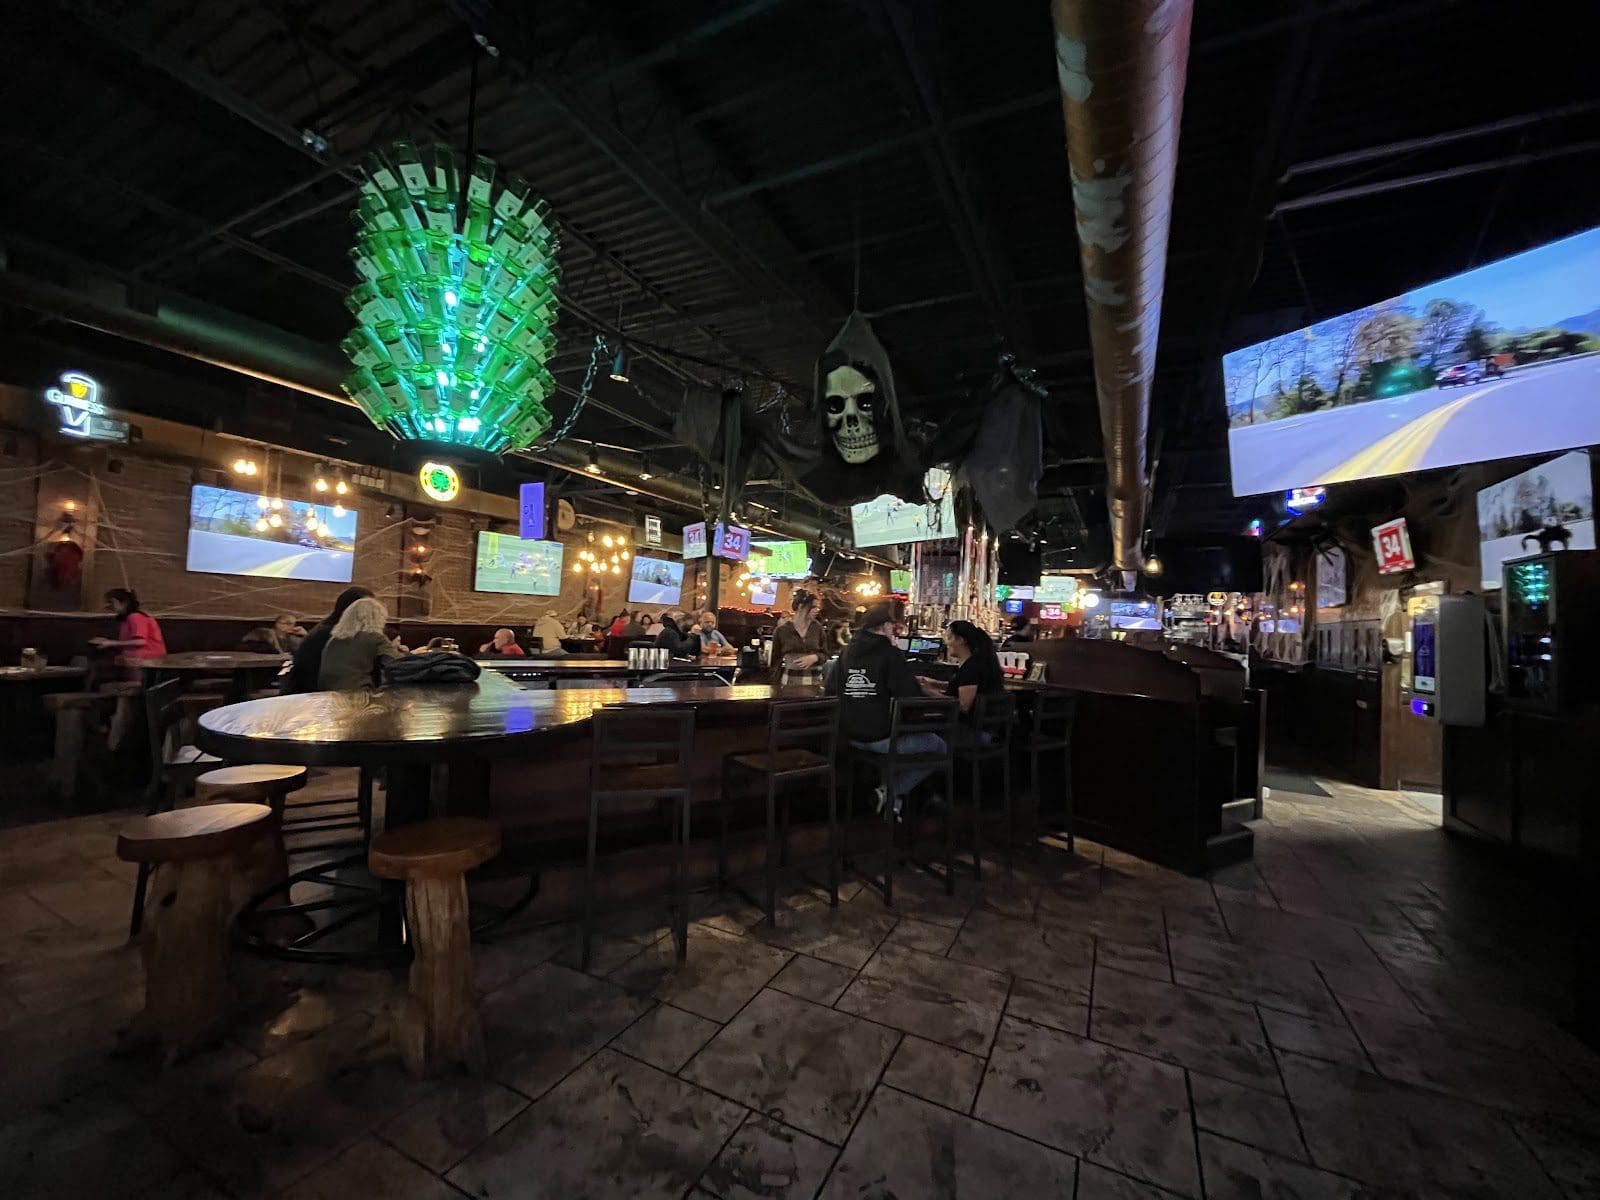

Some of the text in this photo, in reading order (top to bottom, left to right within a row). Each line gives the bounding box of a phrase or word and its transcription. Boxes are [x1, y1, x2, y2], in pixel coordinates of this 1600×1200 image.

[46, 389, 104, 414] GESS
[724, 533, 741, 550] 34
[1382, 534, 1400, 558] 34
